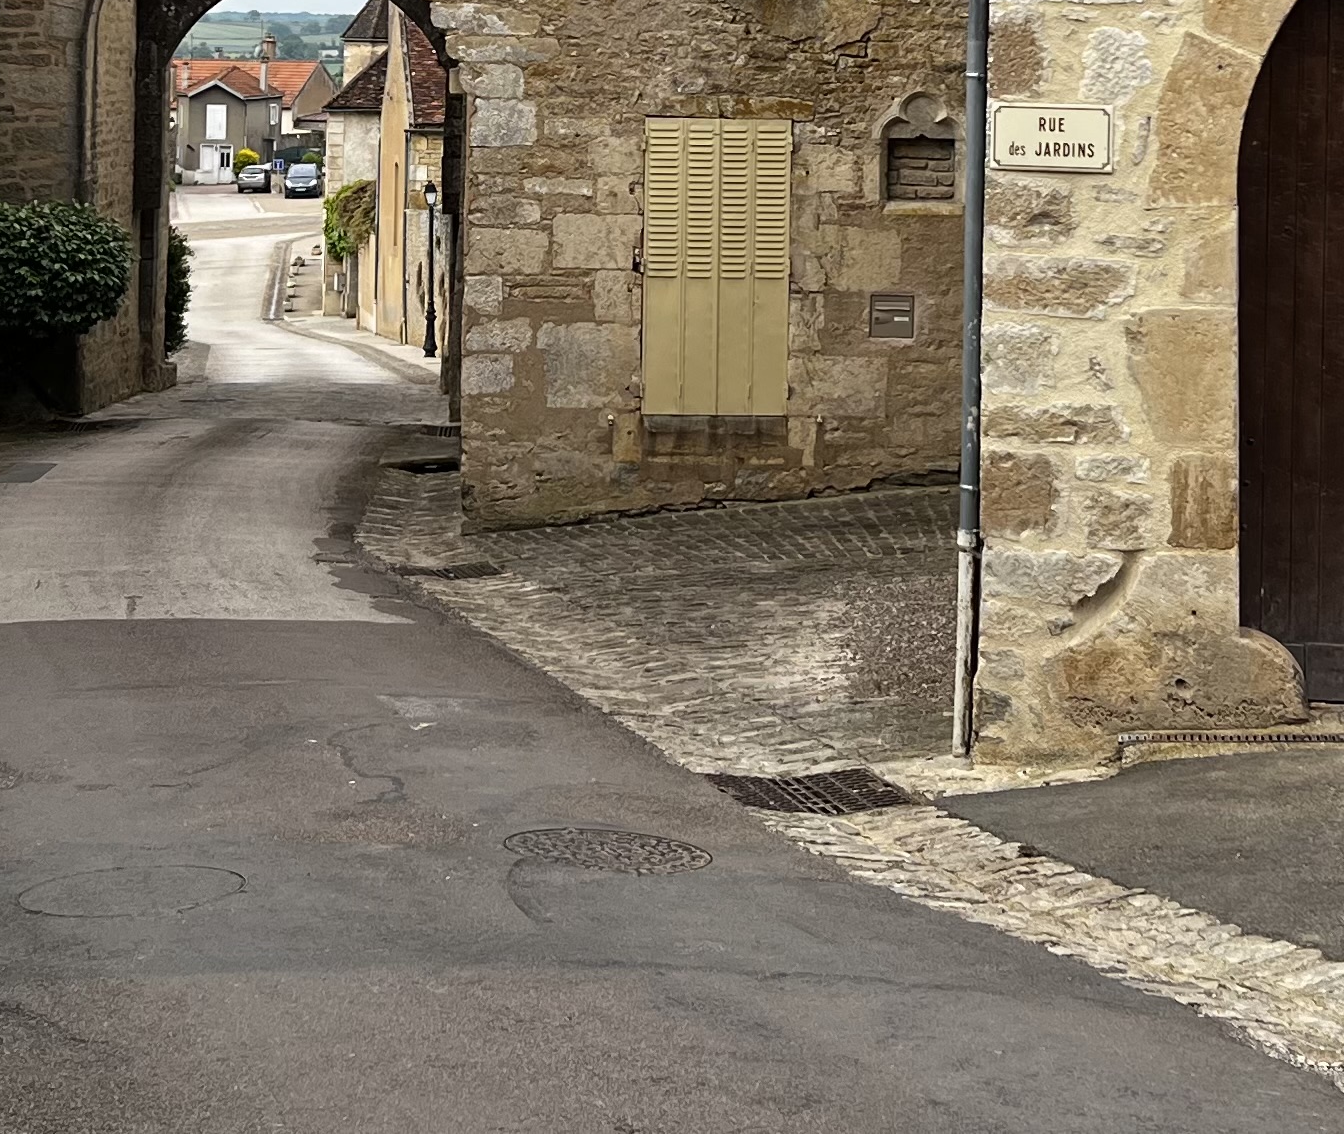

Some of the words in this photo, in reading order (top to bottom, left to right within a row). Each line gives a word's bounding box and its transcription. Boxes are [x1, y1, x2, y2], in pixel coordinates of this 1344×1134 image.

[1038, 117, 1065, 132] RUE
[1008, 141, 1026, 156] des
[1035, 142, 1095, 157] JARDINS
